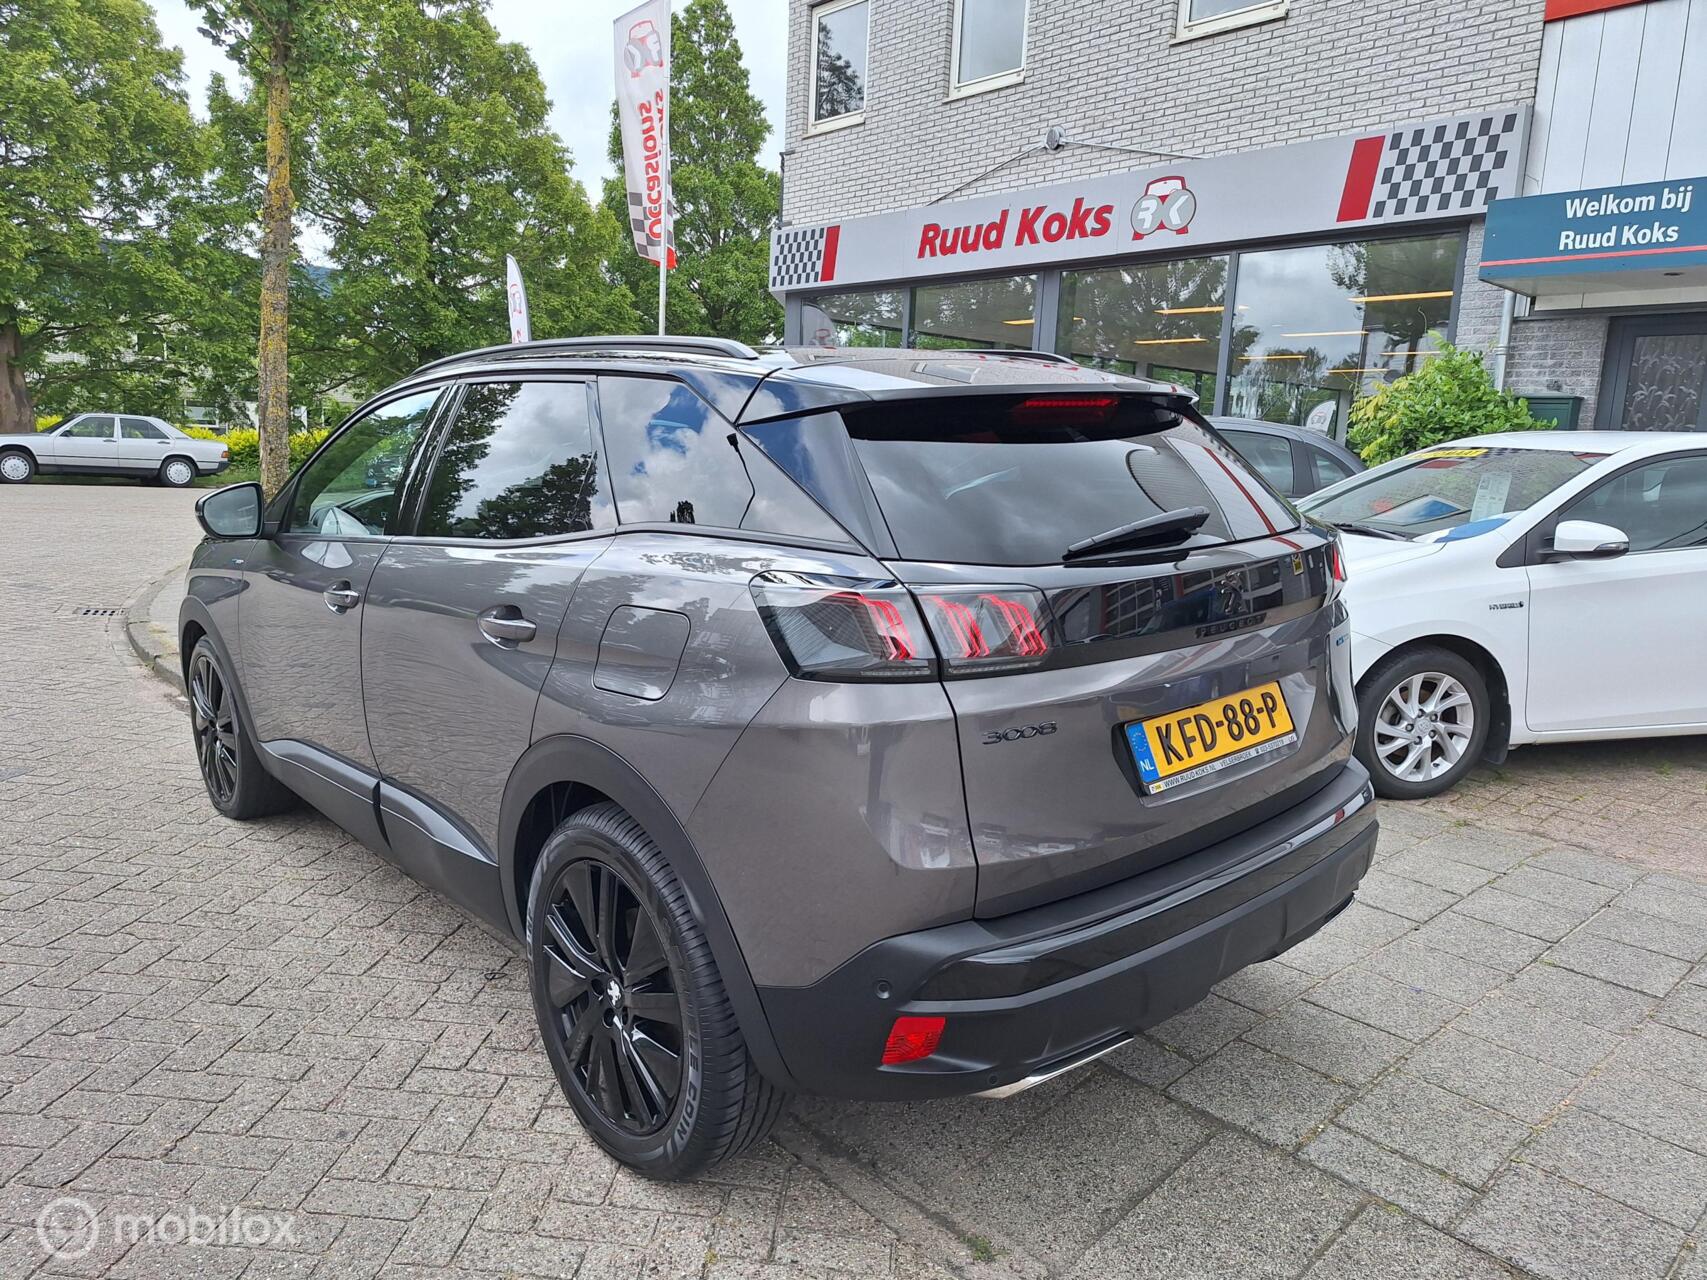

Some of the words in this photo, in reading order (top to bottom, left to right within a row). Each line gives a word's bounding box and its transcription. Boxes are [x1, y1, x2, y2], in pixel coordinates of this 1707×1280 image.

[1565, 193, 1655, 219] Welkom
[1660, 185, 1694, 213] bij
[917, 208, 1010, 259] Ruud
[1014, 197, 1115, 246] Koks
[1558, 225, 1616, 251] Ruud
[1621, 221, 1680, 246] Koks
[982, 720, 1057, 745] 3008
[1155, 691, 1278, 766] KFD-88-P
[1139, 758, 1155, 773] NL
